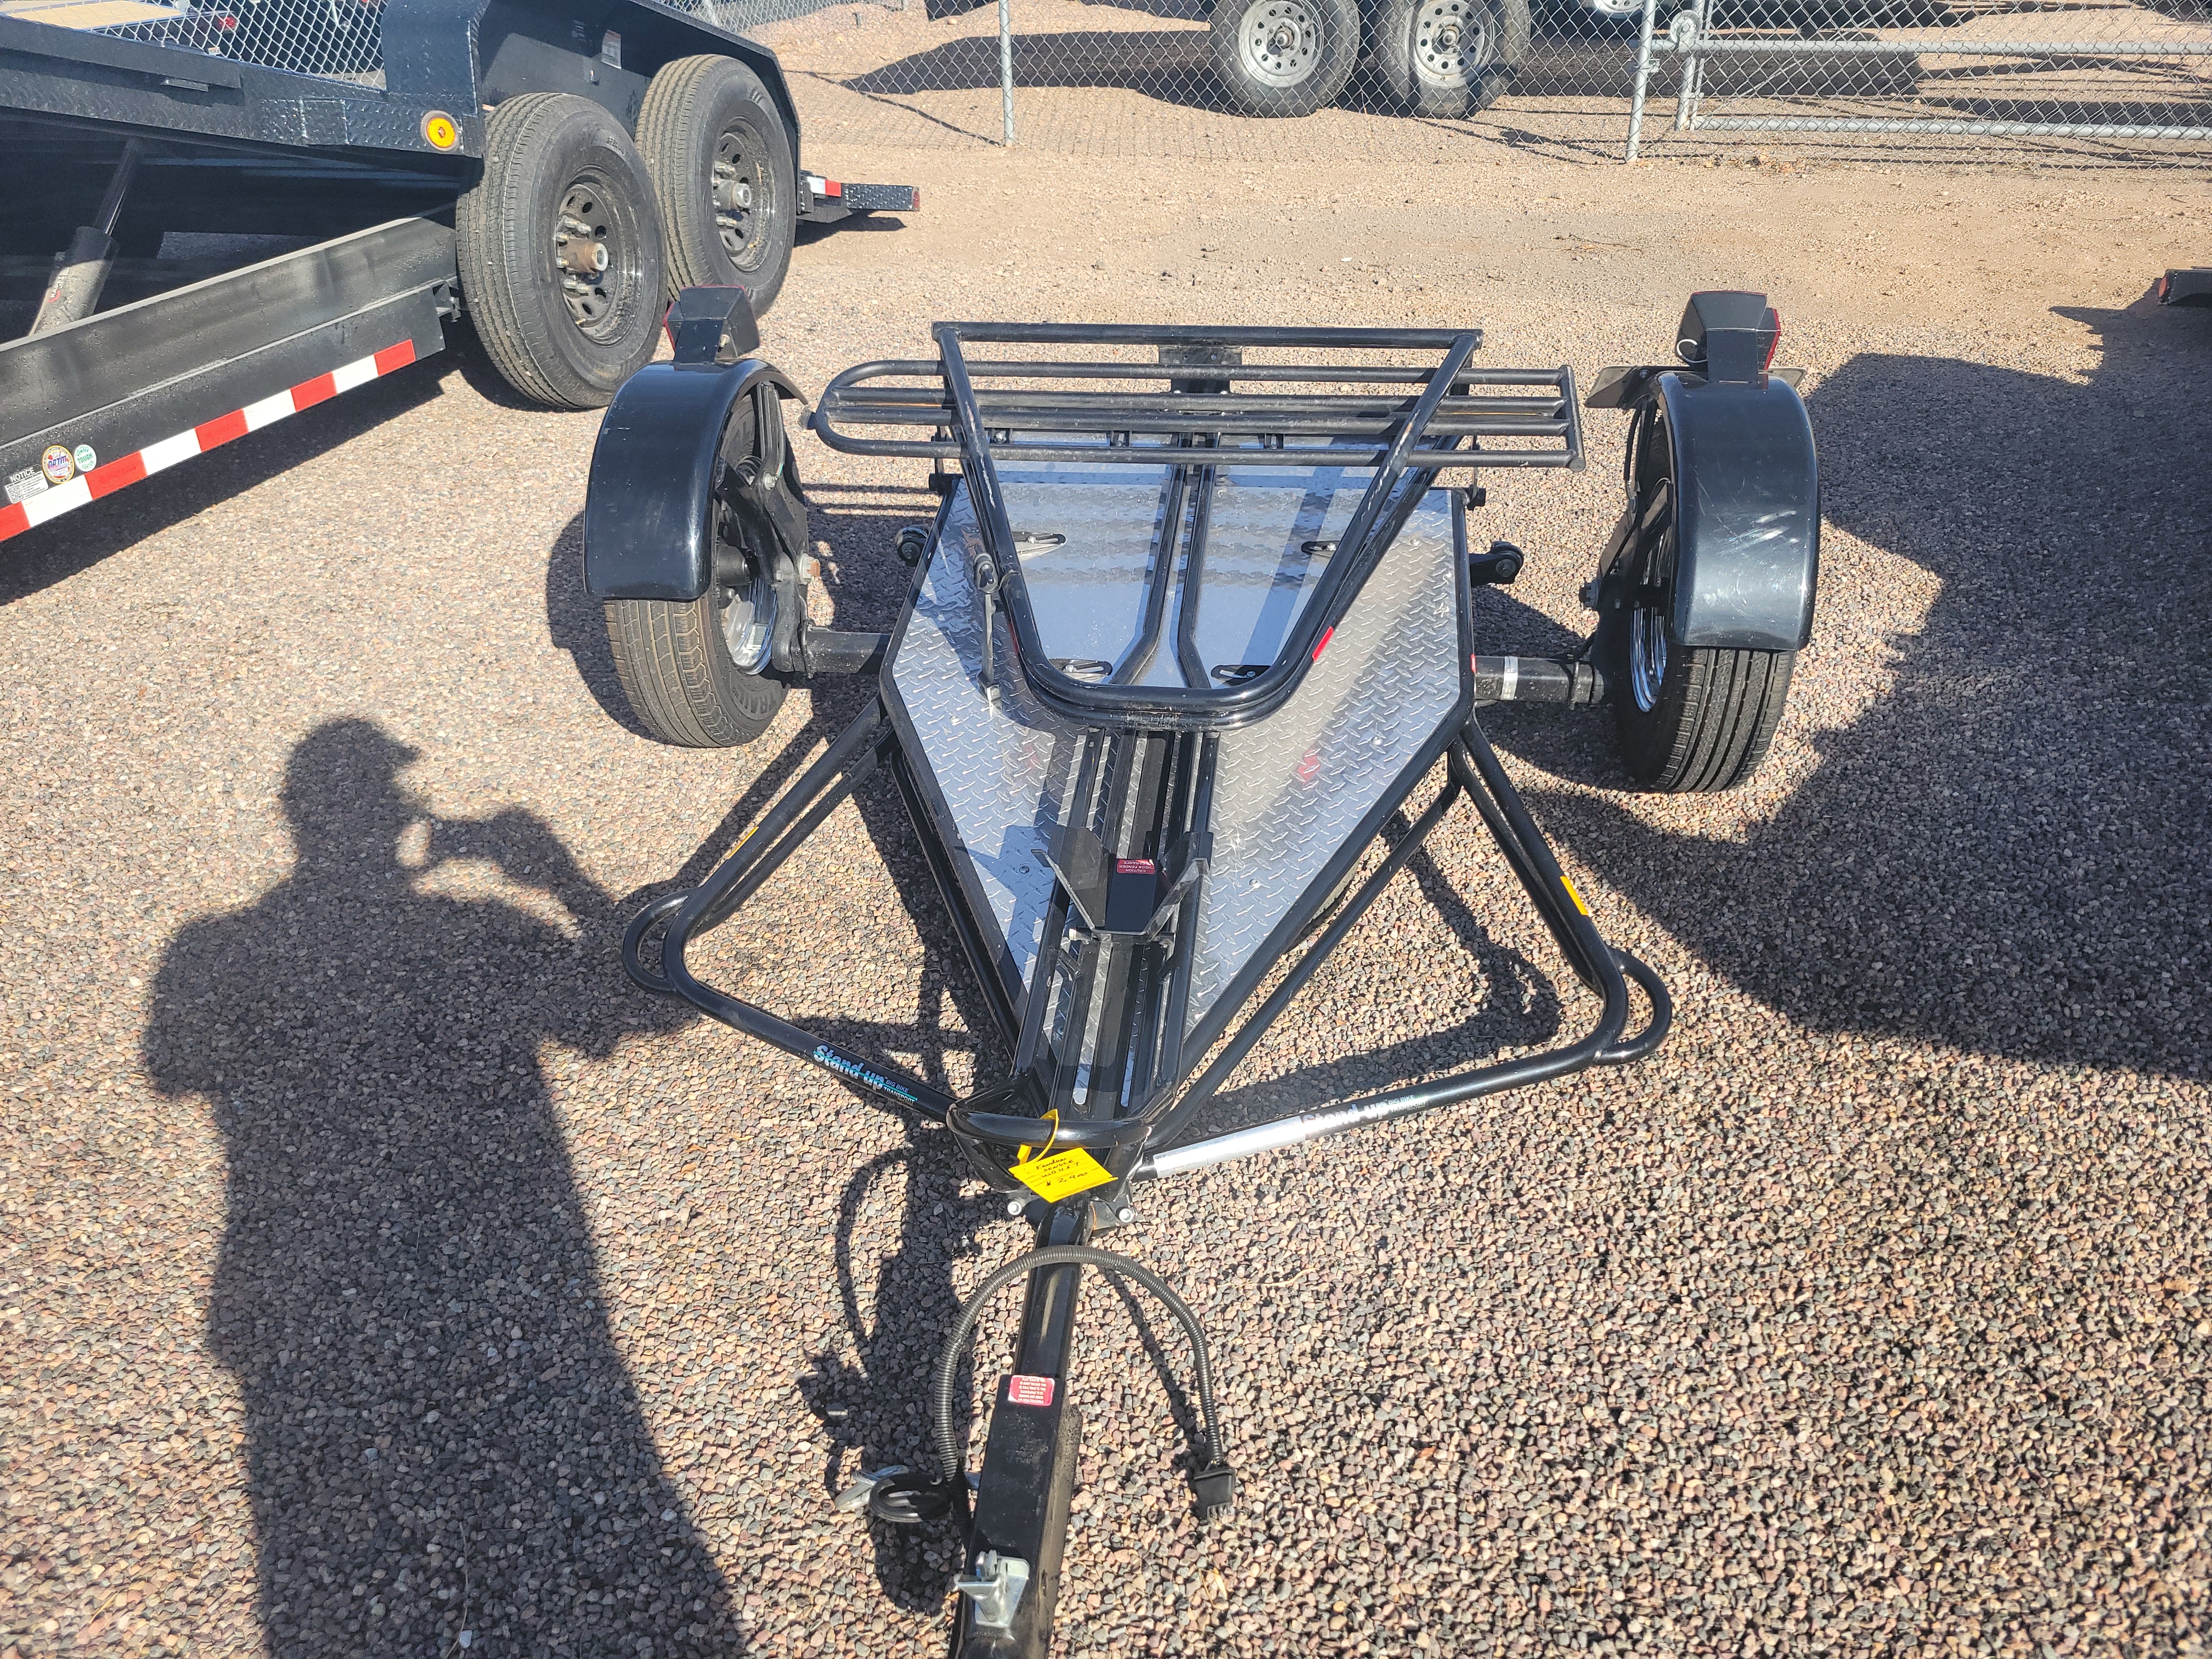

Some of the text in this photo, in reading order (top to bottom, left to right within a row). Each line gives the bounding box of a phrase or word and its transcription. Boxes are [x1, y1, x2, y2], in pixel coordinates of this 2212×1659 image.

[77, 453, 93, 464] TOUGH
[10, 467, 36, 483] NOTICE
[884, 1086, 915, 1104] TRANSPORT
[896, 1084, 910, 1093] BIKE
